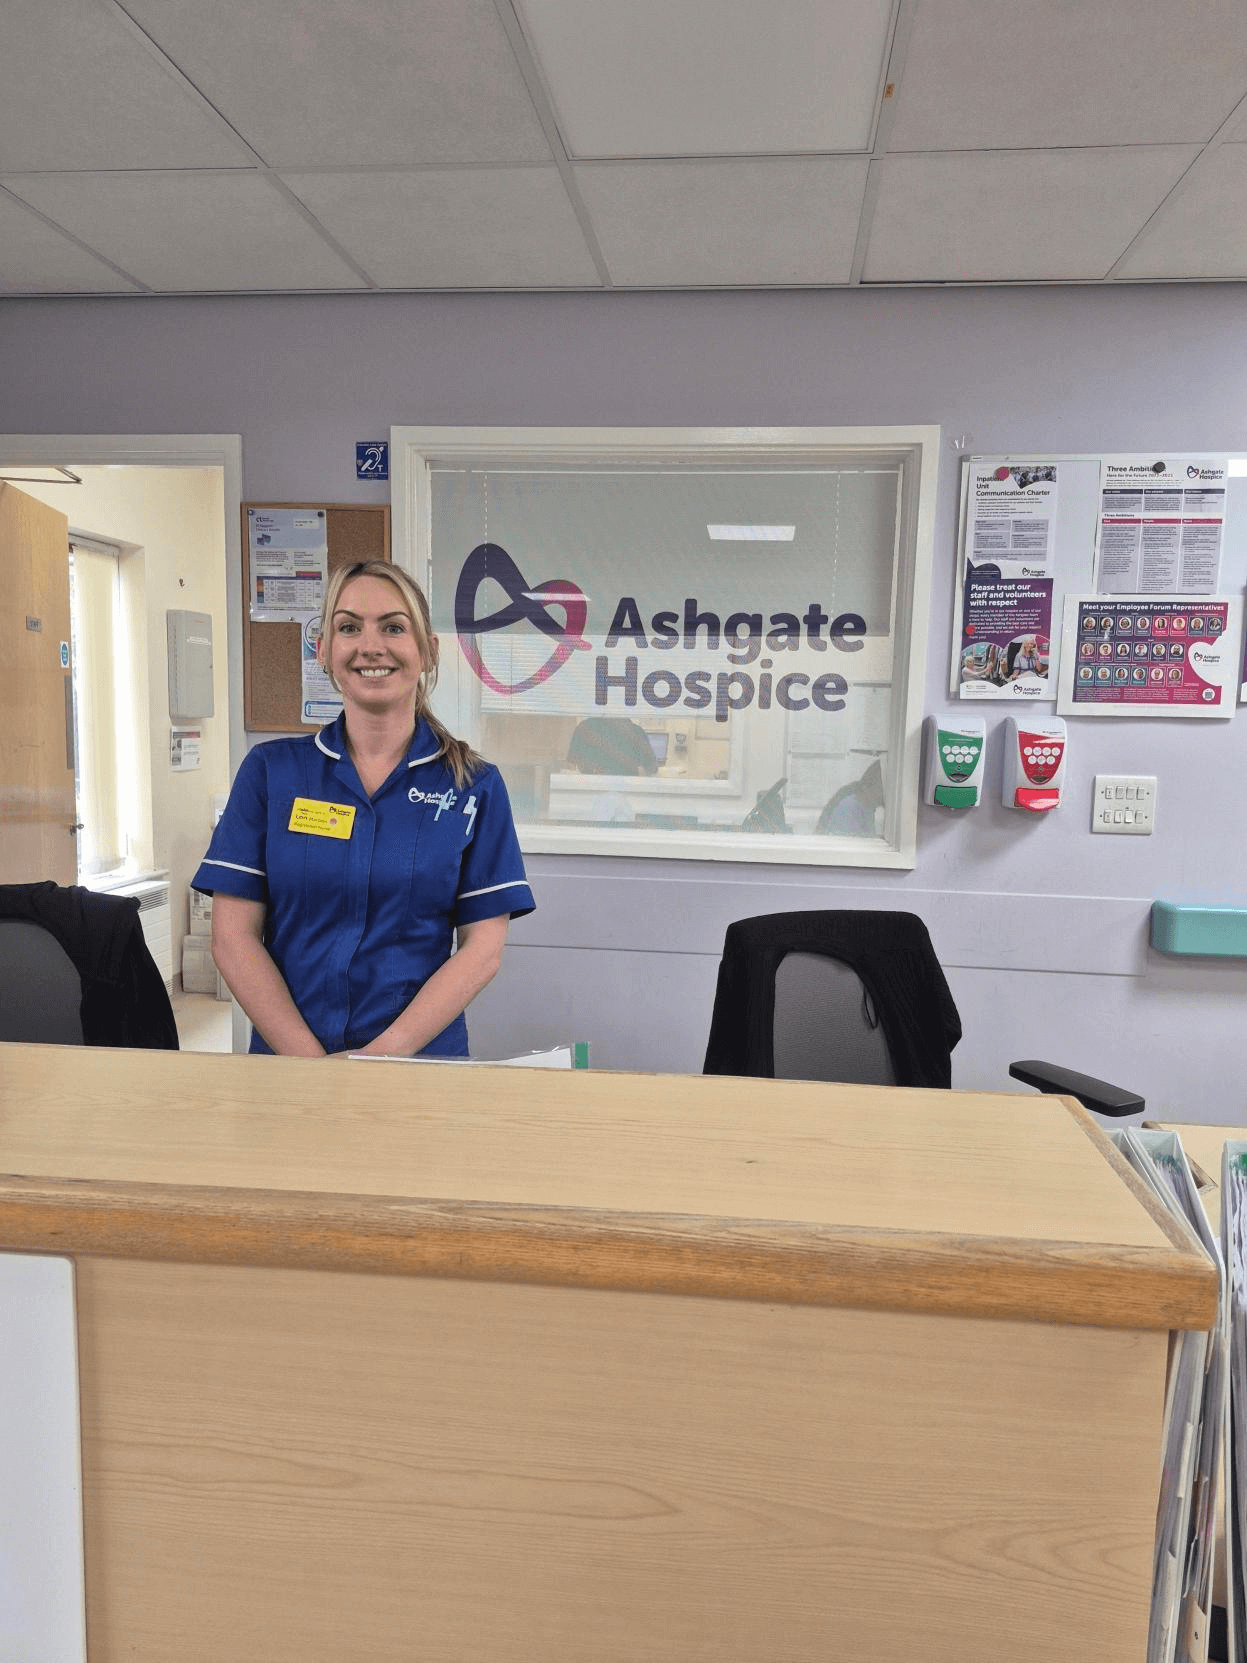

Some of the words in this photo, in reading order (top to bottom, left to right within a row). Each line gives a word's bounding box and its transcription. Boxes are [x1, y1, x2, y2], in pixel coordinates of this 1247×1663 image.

[1129, 464, 1166, 473] Ambiti
[996, 583, 1016, 591] treat
[970, 591, 989, 599] staff
[988, 591, 1004, 599] and
[988, 599, 1018, 607] respect
[1116, 603, 1149, 611] Employee
[1149, 603, 1171, 611] Forum
[604, 597, 867, 665] Ashgate
[594, 655, 849, 723] Hospice
